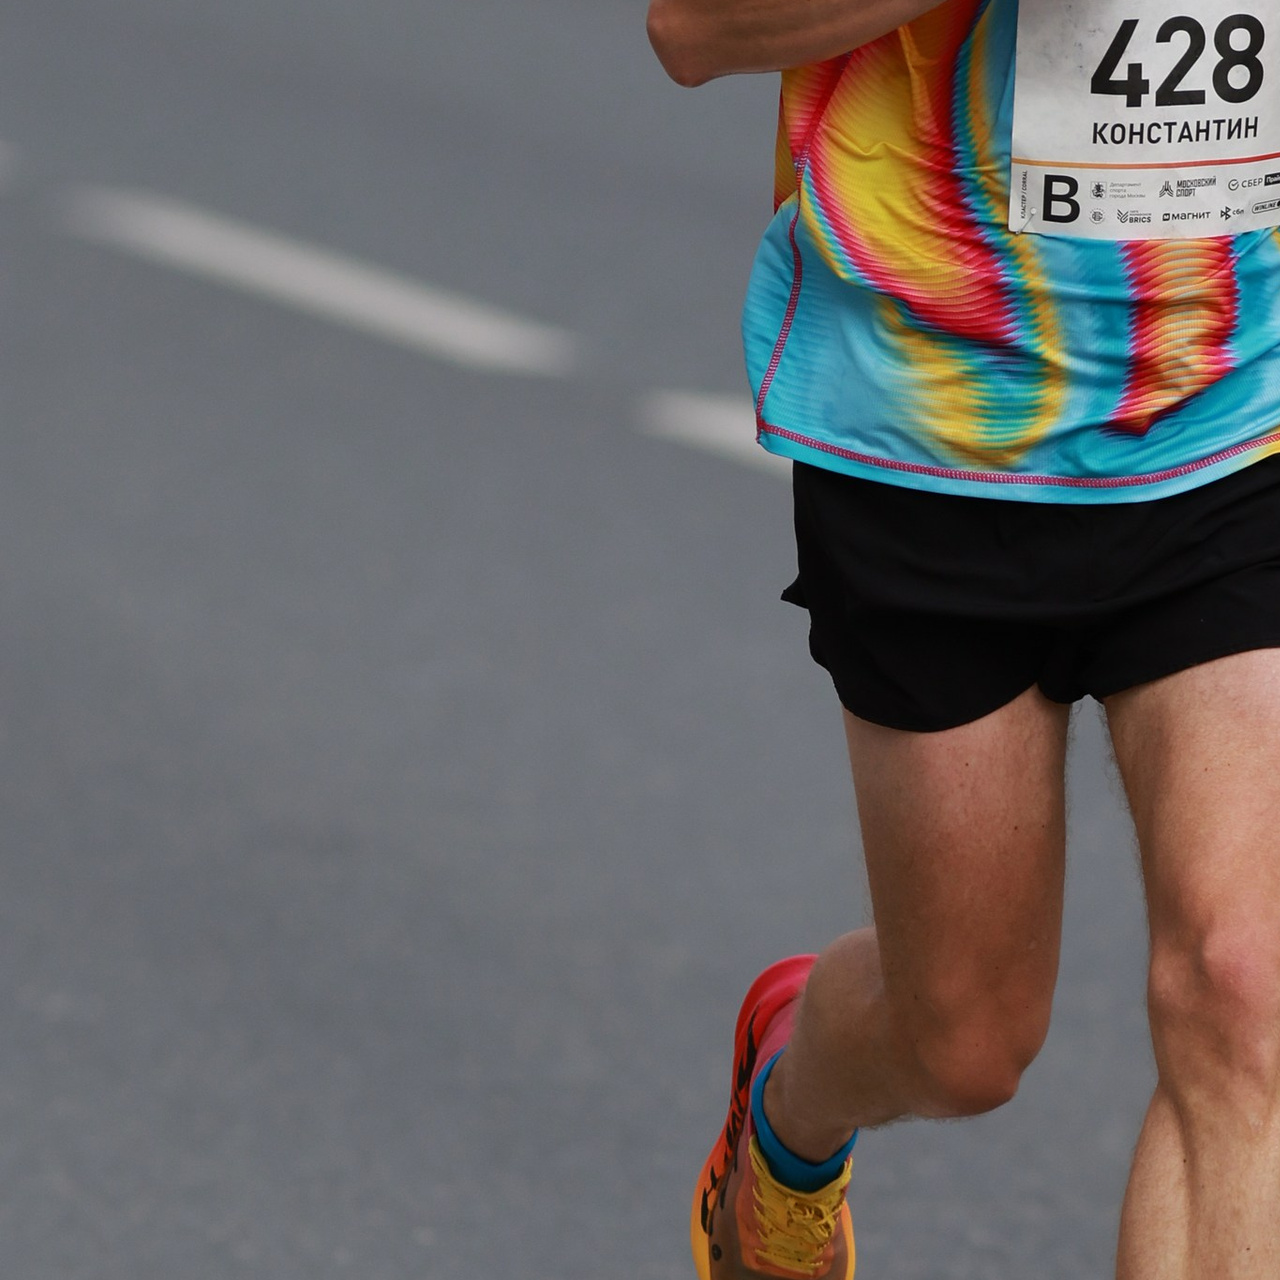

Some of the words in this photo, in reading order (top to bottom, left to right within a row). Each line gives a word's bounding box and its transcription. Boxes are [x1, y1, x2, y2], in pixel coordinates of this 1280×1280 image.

[1090, 13, 1266, 108] 428
[1092, 116, 1259, 145] КОНСТАНТИН
[1176, 176, 1216, 189] МОСКОВСКИЙ
[1241, 177, 1263, 188] СБЕР
[1176, 188, 1196, 198] СПОРТ
